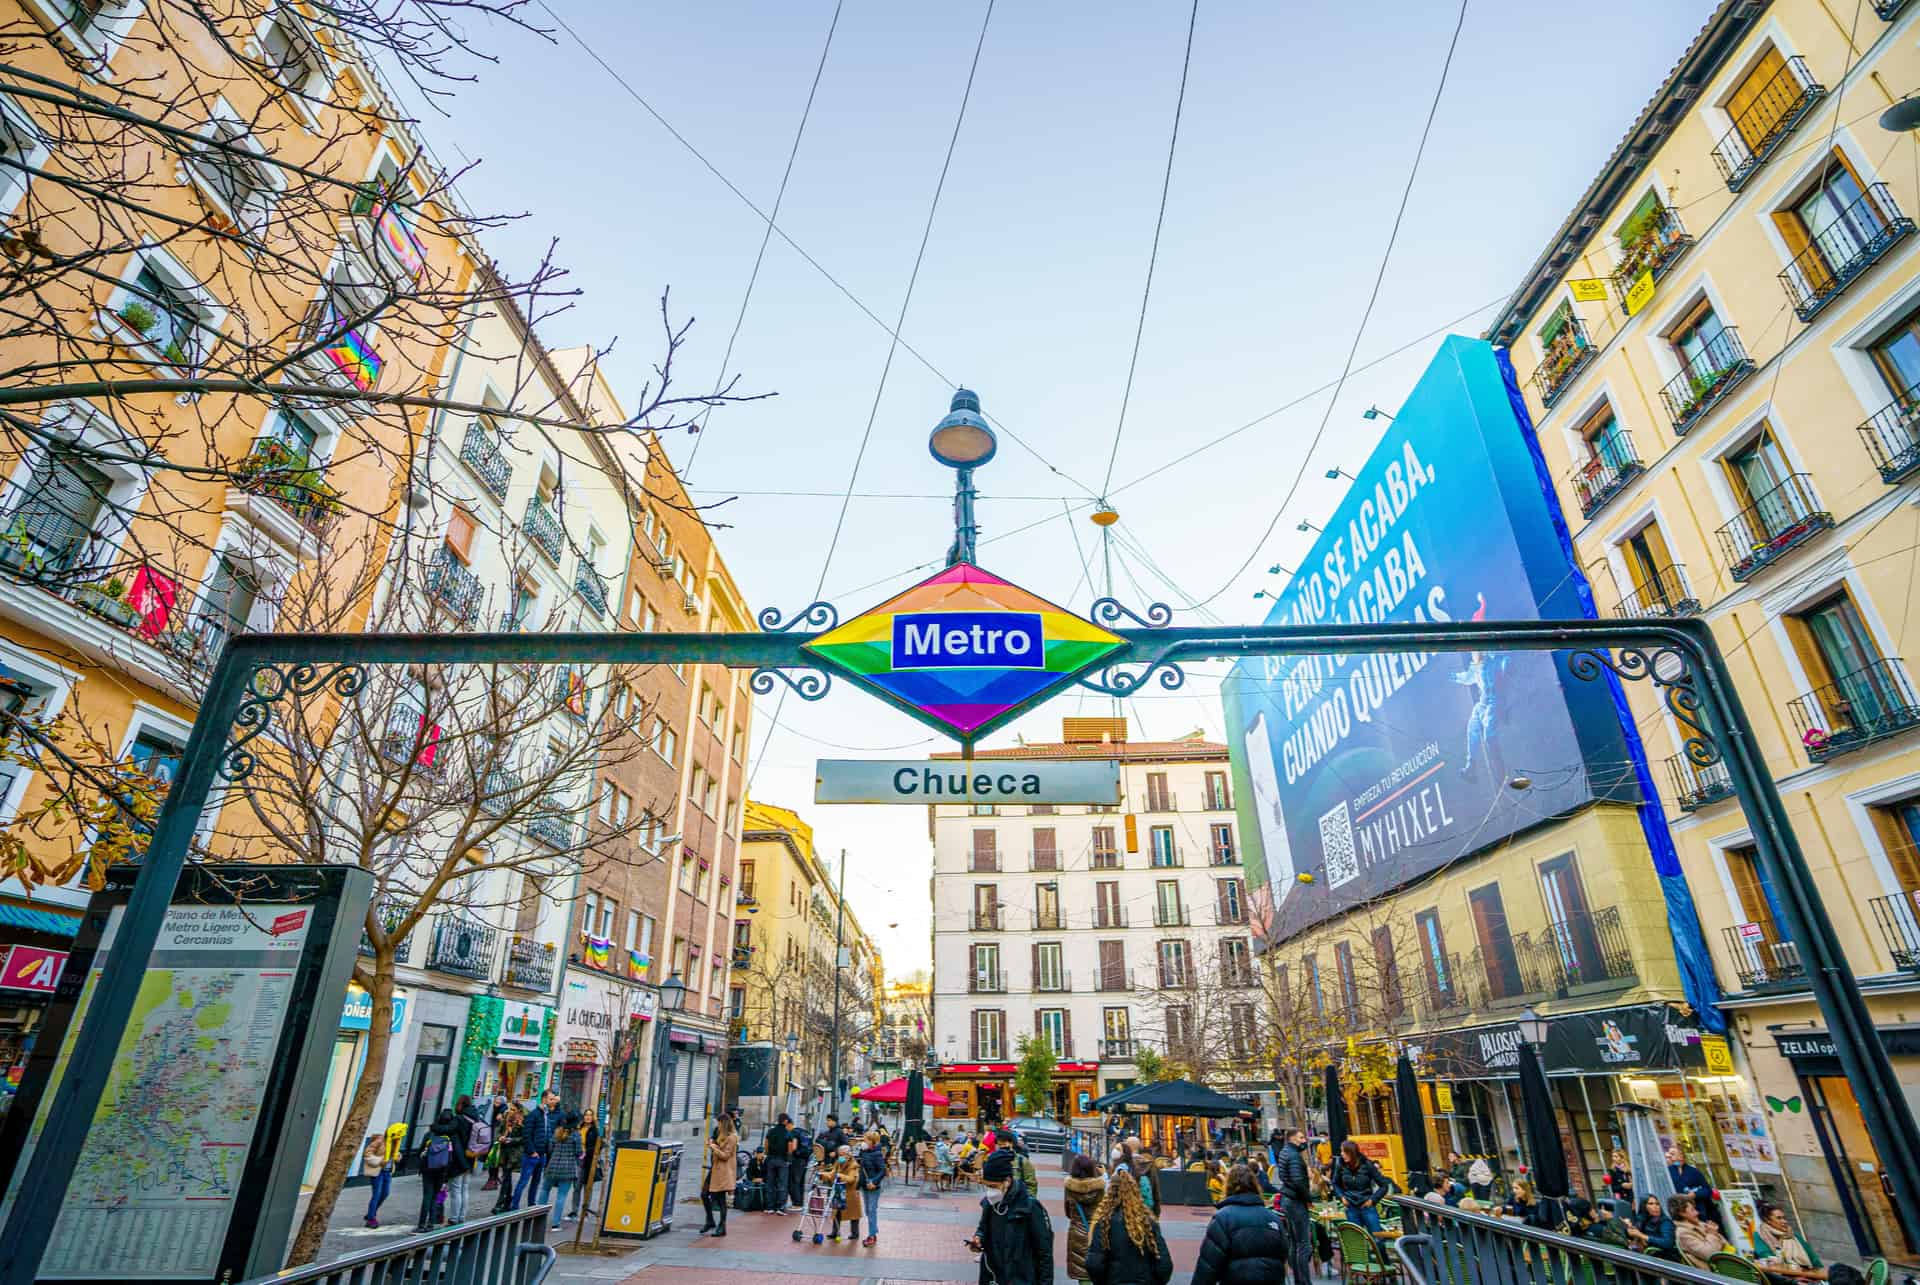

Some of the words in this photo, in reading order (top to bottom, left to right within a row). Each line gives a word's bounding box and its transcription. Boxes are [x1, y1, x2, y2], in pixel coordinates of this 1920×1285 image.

[1323, 536, 1351, 600] SE
[1349, 440, 1435, 573] ACABA,
[904, 623, 1031, 656] Metro
[1283, 688, 1350, 784] CUANDO
[893, 768, 1041, 795] Chueca
[1381, 775, 1392, 791] TU
[1360, 782, 1453, 868] MYHIXEL
[201, 909, 217, 920] de
[164, 922, 200, 933] Metro
[202, 922, 240, 935] Ligero
[173, 934, 233, 945] Cercanías
[567, 1008, 577, 1024] LA
[1781, 1041, 1819, 1054] ZELAI
